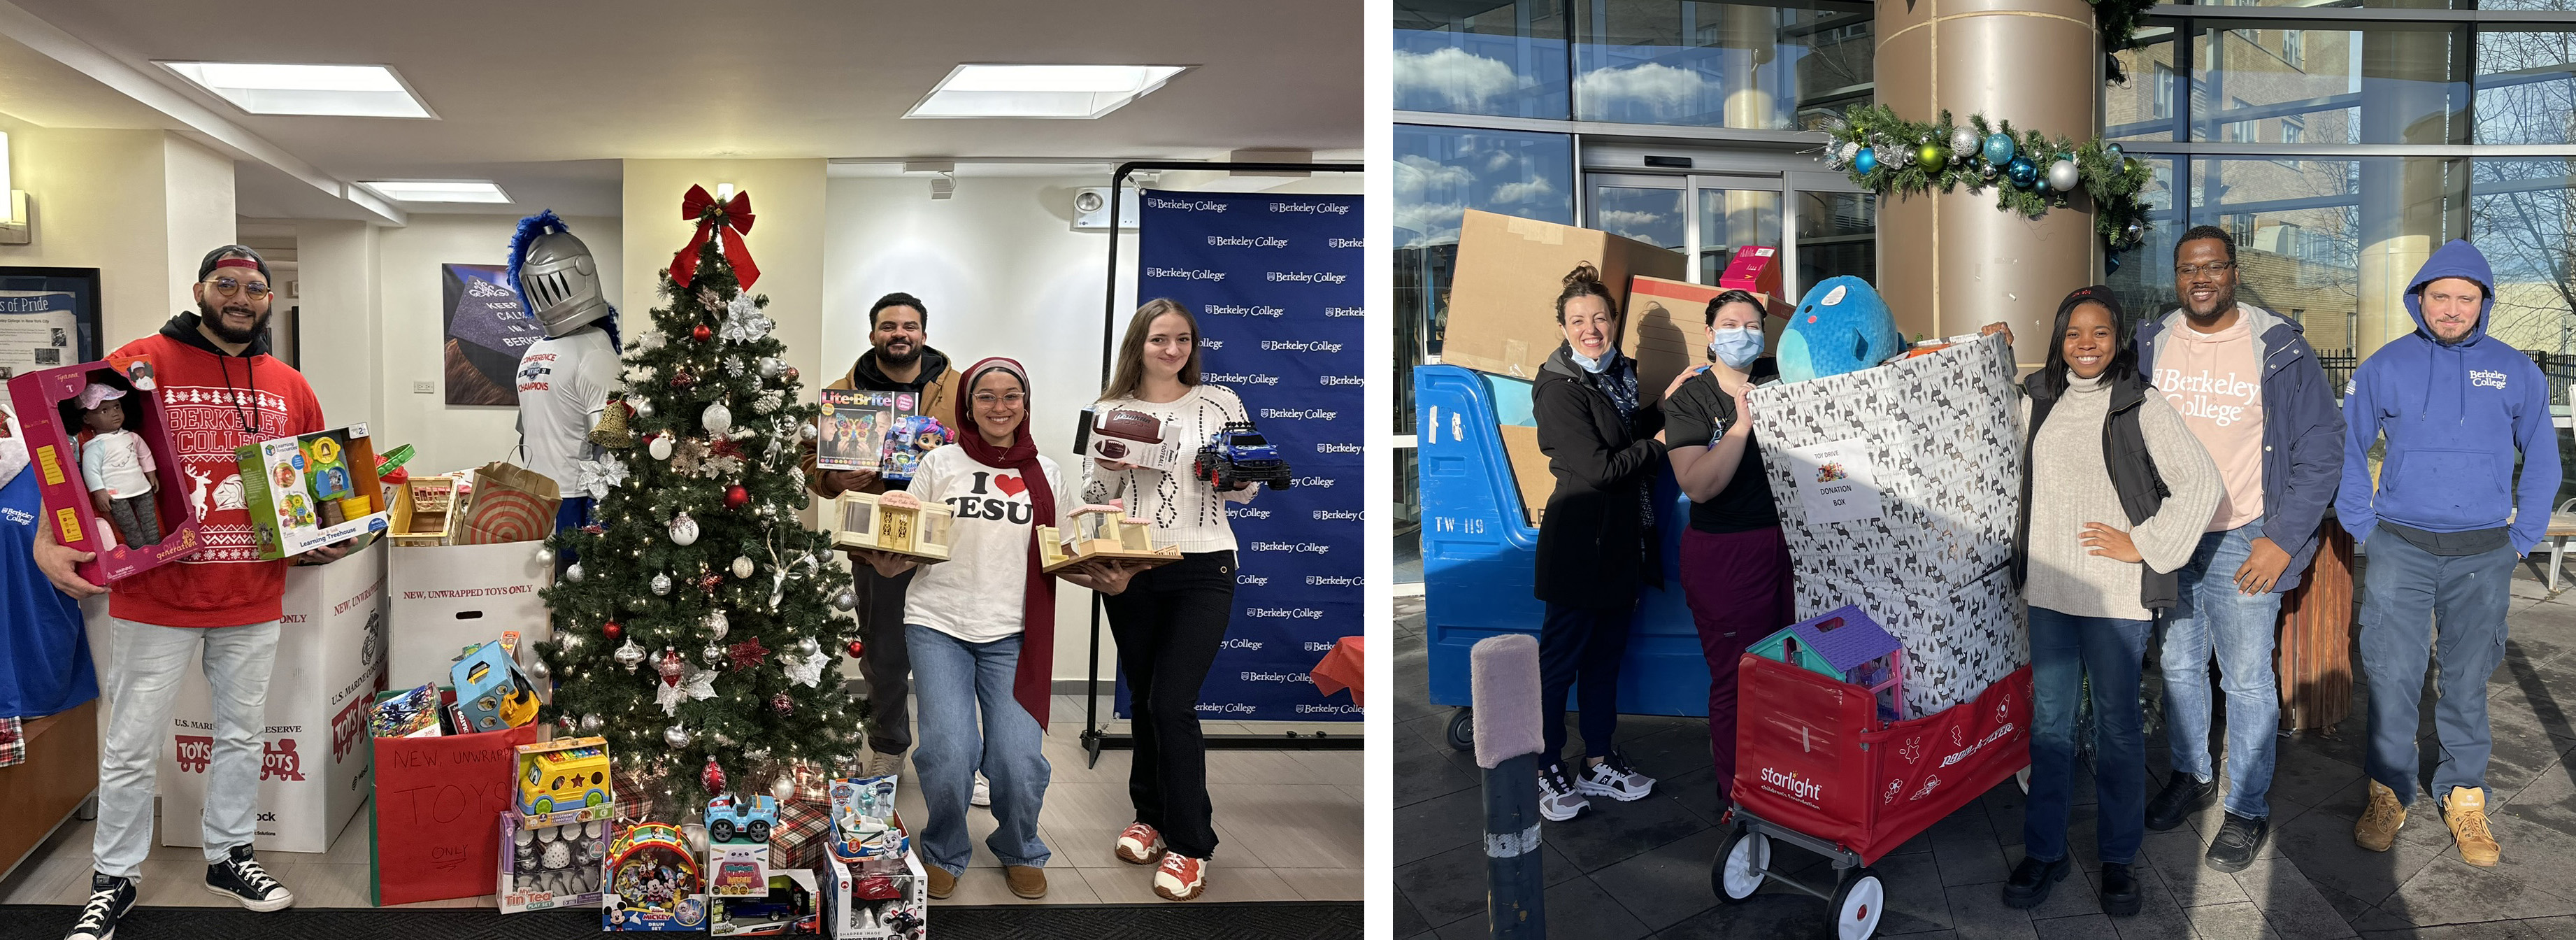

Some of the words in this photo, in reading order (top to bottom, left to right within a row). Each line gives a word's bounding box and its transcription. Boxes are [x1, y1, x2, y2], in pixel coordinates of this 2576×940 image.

[1157, 199, 1194, 211] Berkeley
[1195, 201, 1227, 213] College
[1279, 203, 1315, 214] Berkeley
[1317, 204, 1349, 215] College
[1217, 236, 1254, 248] Berkeley
[1255, 237, 1287, 248] College
[1156, 268, 1191, 280] Berkeley
[1192, 269, 1224, 281] College
[1275, 272, 1312, 283] Berkeley
[1313, 273, 1346, 284] College
[8, 298, 17, 312] of
[22, 297, 49, 311] Pride
[1213, 305, 1249, 316] Berkeley
[1250, 306, 1284, 318] College
[1198, 338, 1224, 350] ollege
[1271, 341, 1308, 352] Berkeley
[1310, 341, 1342, 352] College
[1210, 373, 1247, 385] Berkeley
[1249, 373, 1279, 385] College
[2469, 369, 2507, 381] Berkeley
[518, 383, 549, 392] CHAMPIONS
[1329, 376, 1364, 387] Berkeley
[2162, 369, 2261, 405] Berkeley
[2473, 378, 2507, 390] College
[1113, 411, 1152, 424] Franklin
[1269, 409, 1305, 420] Berkeley
[1305, 410, 1337, 420] College
[166, 408, 287, 436] BERKELEY
[177, 430, 284, 453] COLLE
[1158, 442, 1167, 467] FOOTBALL
[1326, 443, 1361, 455] Berkeley
[971, 471, 989, 494] I
[1302, 476, 1335, 487] College
[1820, 485, 1852, 495] DONATION
[6, 514, 31, 525] College
[7, 508, 35, 520] Berkeley
[1239, 508, 1271, 519] College
[1322, 511, 1358, 521] Berkeley
[1436, 516, 1455, 532] TW
[1465, 518, 1484, 534] 119
[299, 536, 327, 548] Learning
[327, 527, 357, 540] Treehouse
[156, 540, 198, 560] generation
[1259, 542, 1294, 553] Berkeley
[1296, 543, 1329, 553] College
[1237, 575, 1268, 585] College
[1315, 576, 1351, 587] Berkeley
[334, 600, 351, 616] NEW,
[352, 581, 380, 607] UNWRAPPED
[403, 591, 427, 600] NEW,
[428, 589, 483, 599] UNWRAPPED
[485, 587, 508, 596] TOYS
[508, 585, 533, 594] ONLY
[280, 614, 308, 624] ONLY
[1257, 608, 1291, 619] Berkeley
[1292, 608, 1323, 619] College
[1230, 639, 1263, 650] College
[1250, 672, 1287, 683] Berkeley
[331, 691, 345, 706] U.S.
[345, 673, 366, 697] MARINE
[1194, 703, 1224, 713] erkeley
[1225, 704, 1256, 713] College
[1305, 704, 1340, 714] Berkeley
[175, 719, 189, 727] U.S.
[335, 707, 357, 744] TOYS
[179, 741, 212, 760] TOYS
[1938, 745, 1974, 768] RADIO
[1982, 722, 2013, 746] FLYER
[394, 750, 443, 769] NEW,
[1761, 767, 1820, 801] starlight
[393, 781, 508, 825] TOYS
[1787, 793, 1821, 811] foundation
[431, 844, 468, 860] ONLY
[505, 894, 527, 906] Tin
[529, 892, 552, 904] Tea
